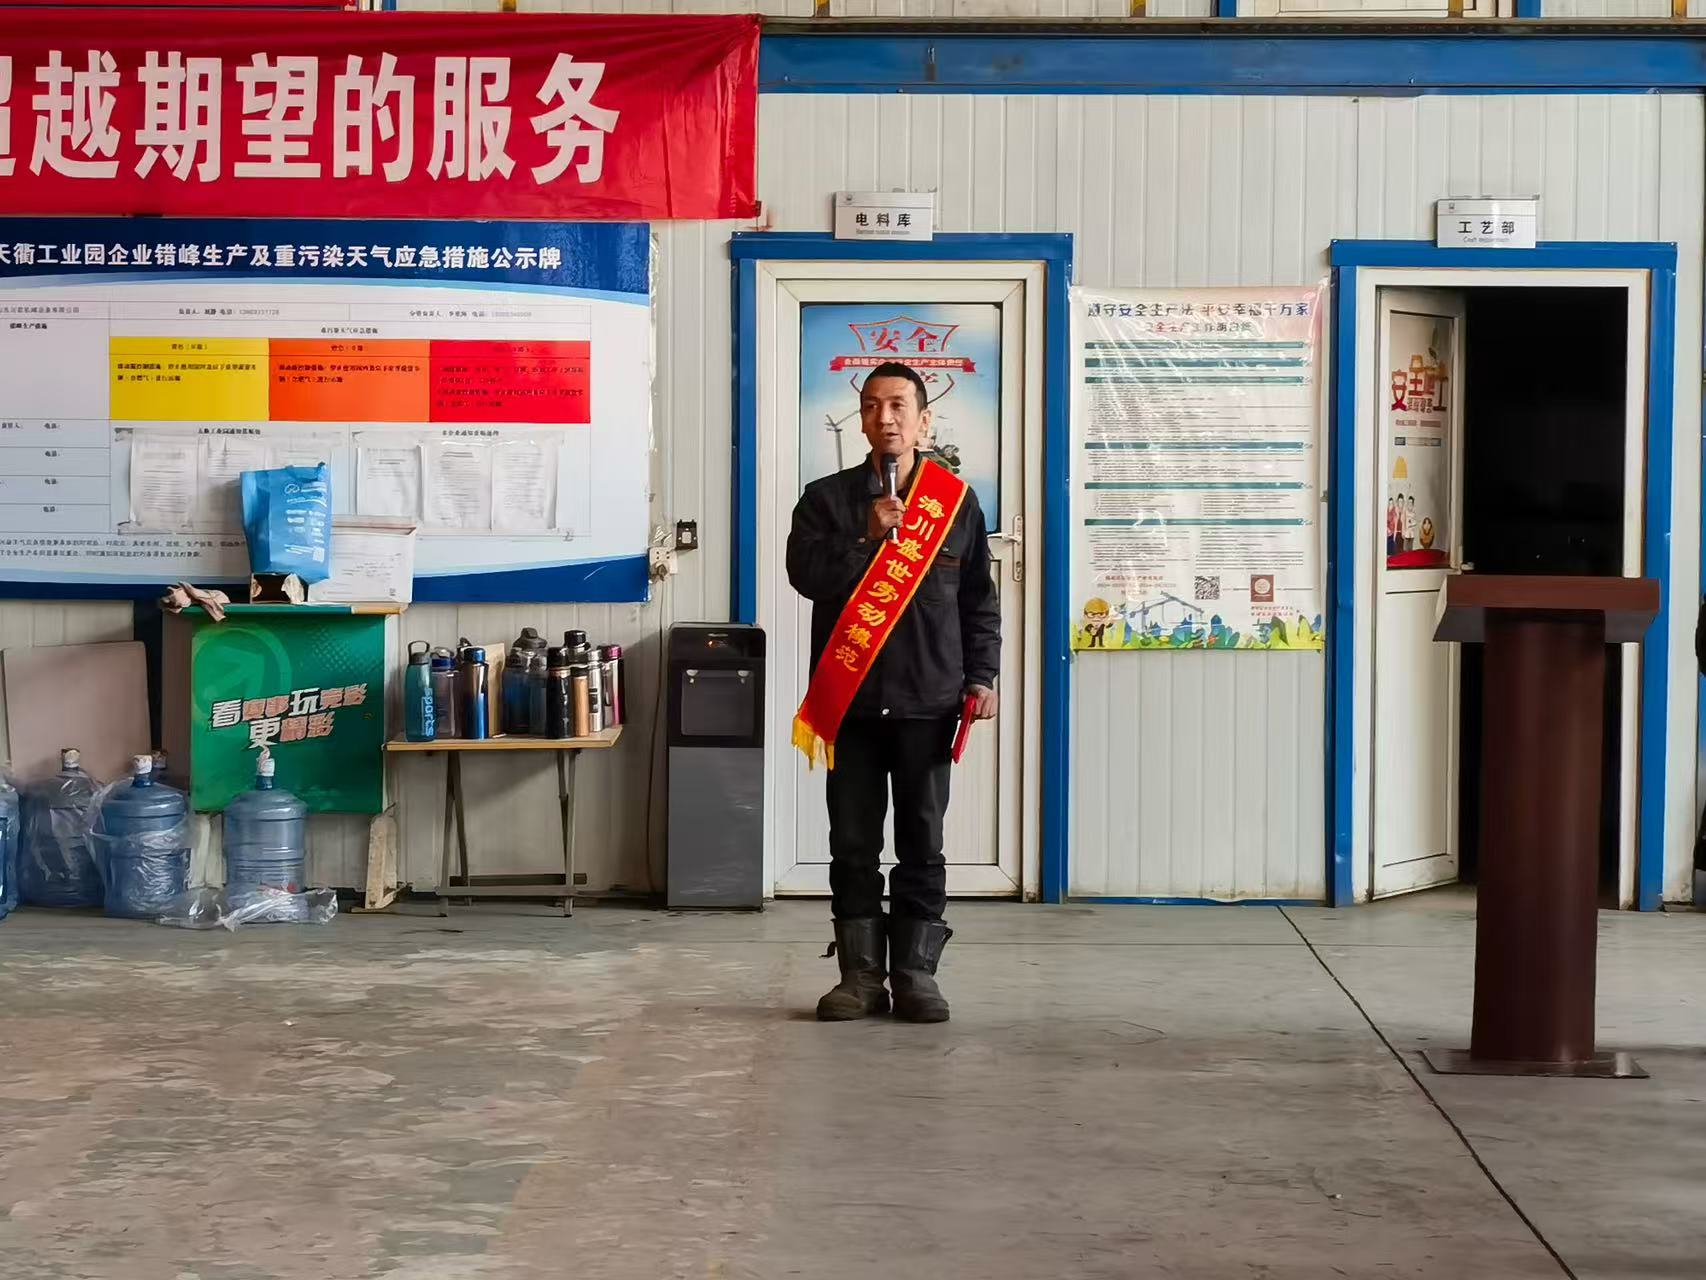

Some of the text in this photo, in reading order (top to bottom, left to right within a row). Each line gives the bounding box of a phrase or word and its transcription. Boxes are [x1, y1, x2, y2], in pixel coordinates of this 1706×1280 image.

[0, 49, 621, 184] 越期望的服务
[856, 212, 911, 227] 电料库
[1457, 221, 1515, 235] 工艺部
[870, 327, 938, 353] 安全
[834, 494, 945, 673] 海川盛世劳动模范
[424, 687, 435, 737] sports
